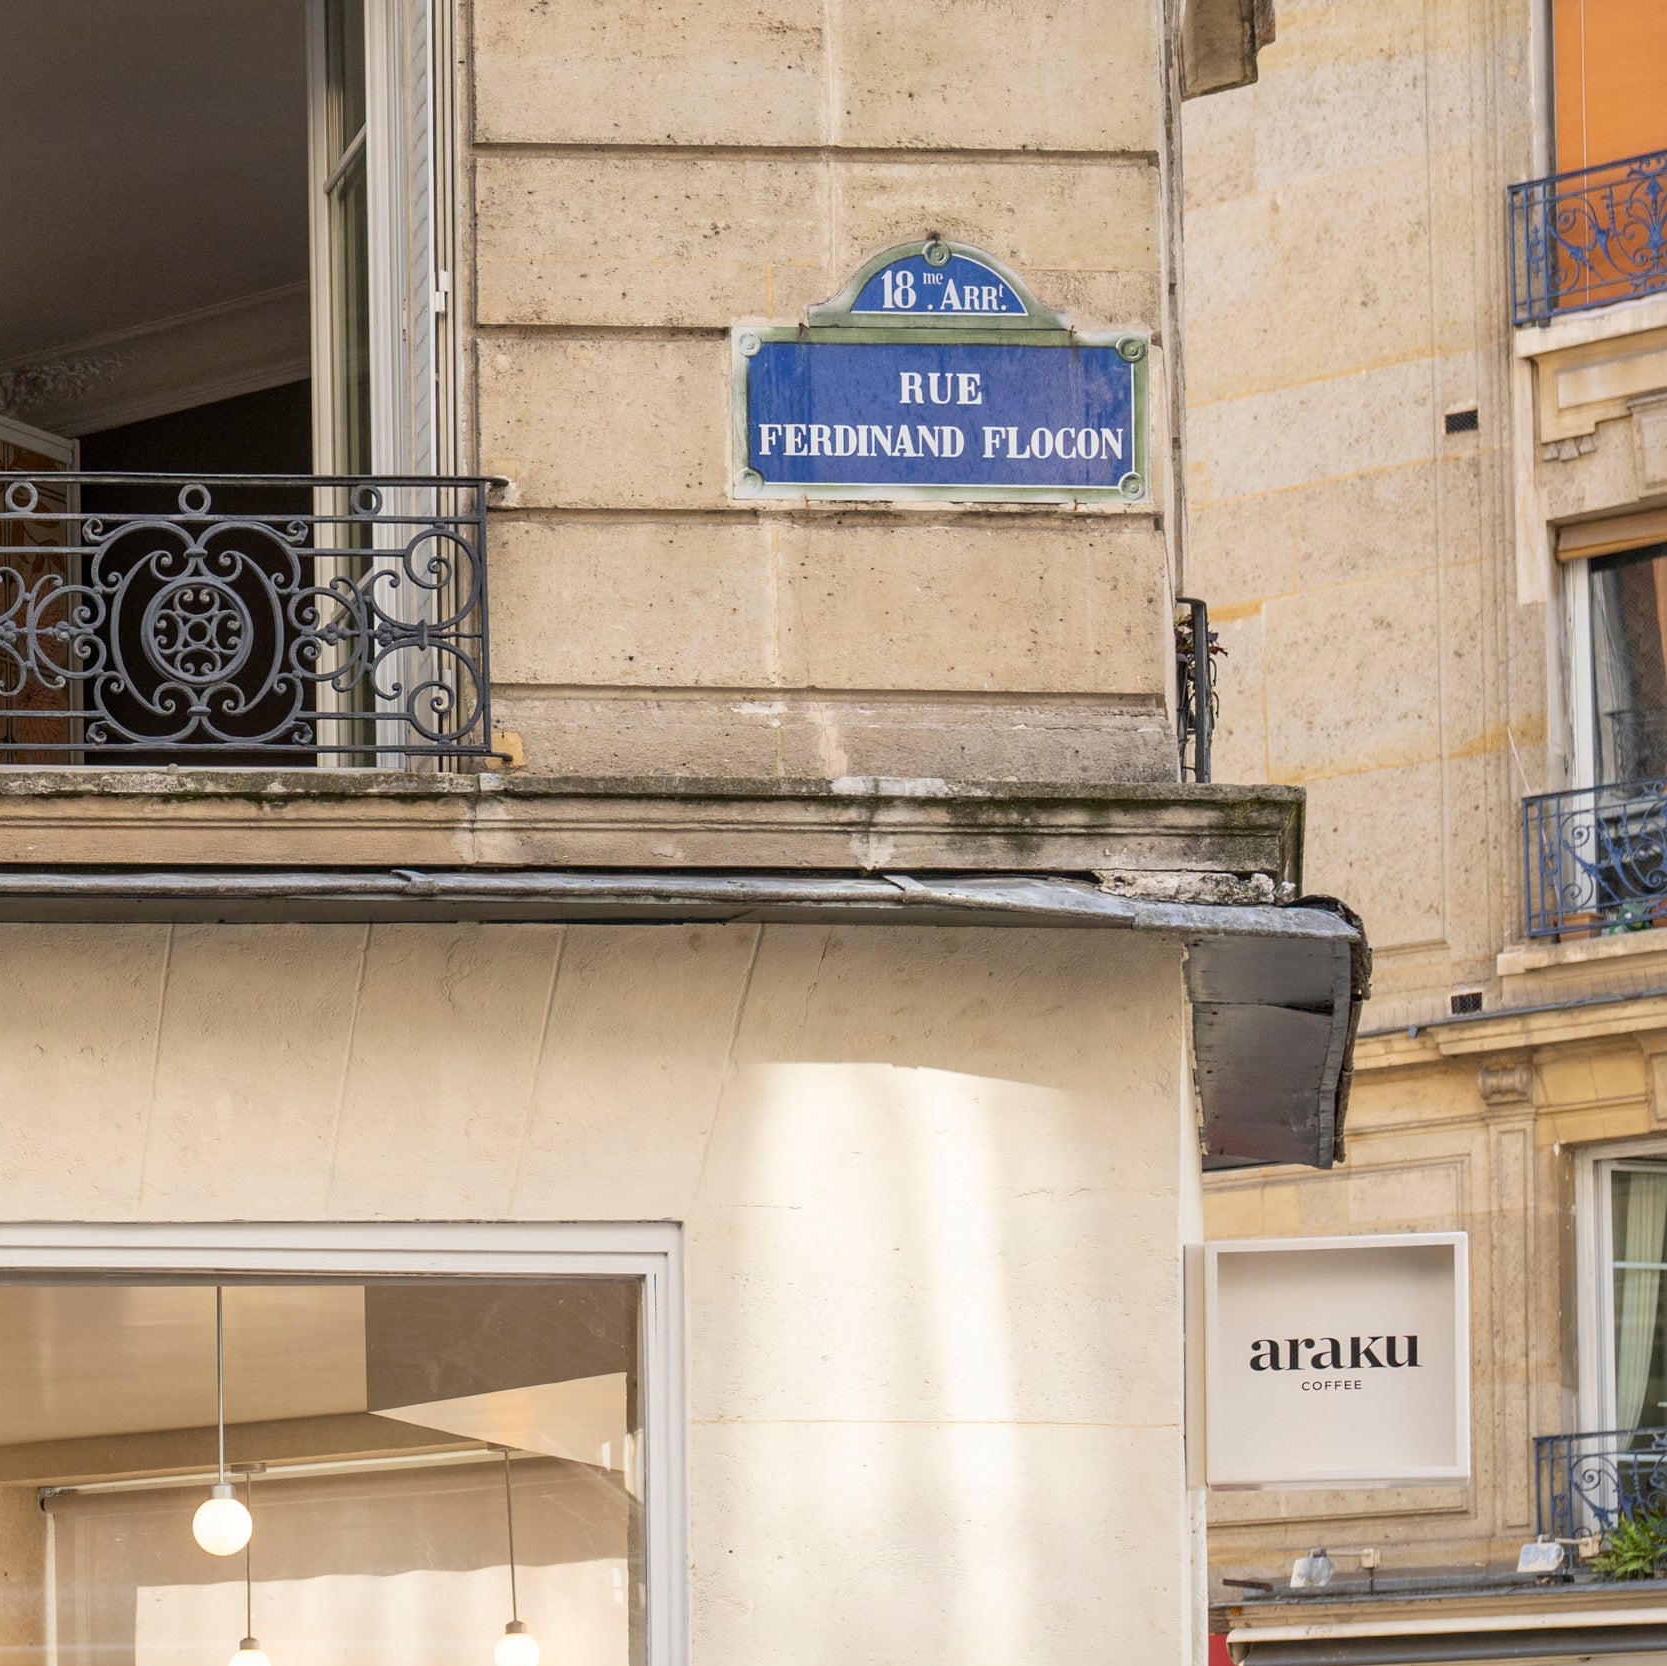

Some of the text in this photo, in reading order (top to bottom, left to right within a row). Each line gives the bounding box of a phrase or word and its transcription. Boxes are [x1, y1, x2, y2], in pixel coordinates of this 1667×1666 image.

[900, 372, 982, 405] RUE
[759, 424, 1124, 459] FERDINAND FLOCON
[1249, 1335, 1422, 1372] araku
[1301, 1379, 1362, 1391] COFFEE
